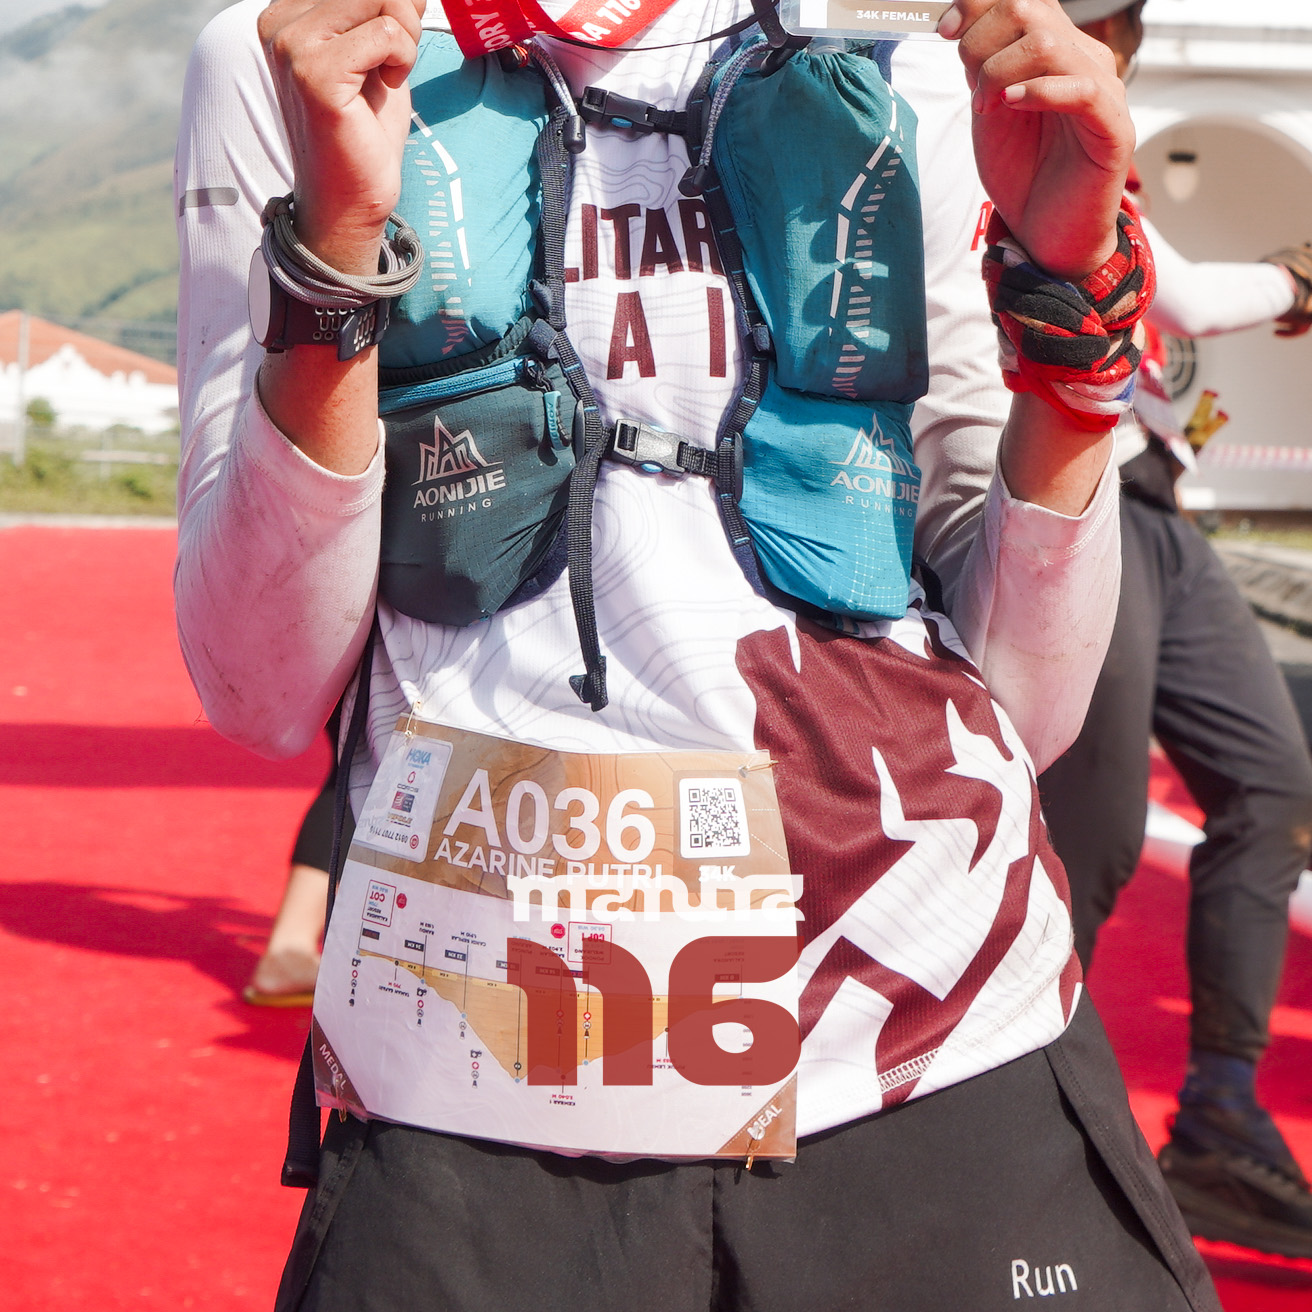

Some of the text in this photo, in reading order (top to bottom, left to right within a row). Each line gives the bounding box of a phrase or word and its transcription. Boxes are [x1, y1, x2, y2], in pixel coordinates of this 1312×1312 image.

[856, 9, 931, 23] 34K FEMALE
[413, 469, 507, 509] AONIJIE
[829, 470, 921, 504] AONIJIE
[421, 498, 493, 523] RUNNING
[844, 495, 914, 519] RUNNING
[442, 767, 657, 864] A036
[434, 837, 664, 887] AZARINE PUTRI
[370, 891, 385, 903] COT
[319, 1043, 348, 1090] MEDAL
[1012, 1257, 1078, 1300] Run
